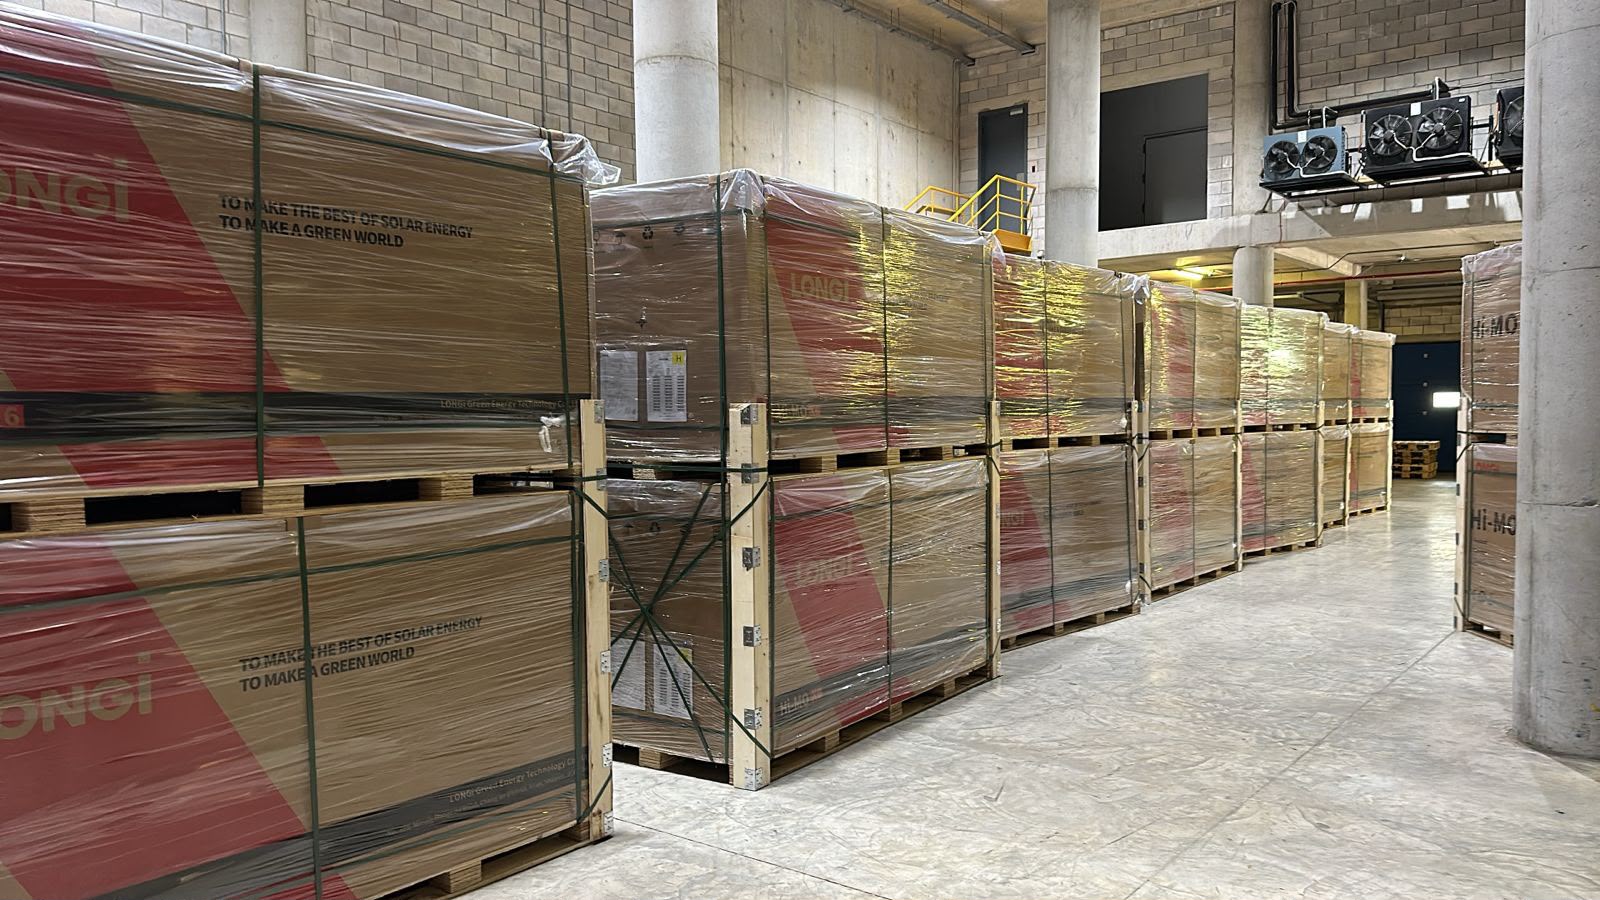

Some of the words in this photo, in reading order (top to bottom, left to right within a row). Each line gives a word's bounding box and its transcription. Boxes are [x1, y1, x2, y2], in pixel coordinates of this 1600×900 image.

[0, 158, 129, 222] NGi
[219, 214, 241, 229] TO
[245, 217, 289, 235] MAKE
[291, 223, 302, 236] A
[304, 224, 352, 241] GREEN
[354, 230, 404, 248] WORLD
[221, 196, 240, 210] TO
[244, 199, 288, 215] MAKE
[289, 203, 320, 219] THE
[323, 207, 356, 224] BEST
[361, 211, 379, 227] OF
[380, 215, 423, 232] SOLAR
[424, 222, 473, 238] ENERGY
[240, 656, 261, 672] TO
[263, 648, 306, 669] MAKE
[338, 636, 373, 655] BEST
[375, 632, 393, 648] OF
[395, 626, 434, 643] SOLAR
[435, 616, 482, 636] ENERGY
[240, 676, 260, 692] TO
[264, 668, 306, 687] MAKE
[320, 655, 366, 676] GREEN
[368, 646, 415, 667] WORLD
